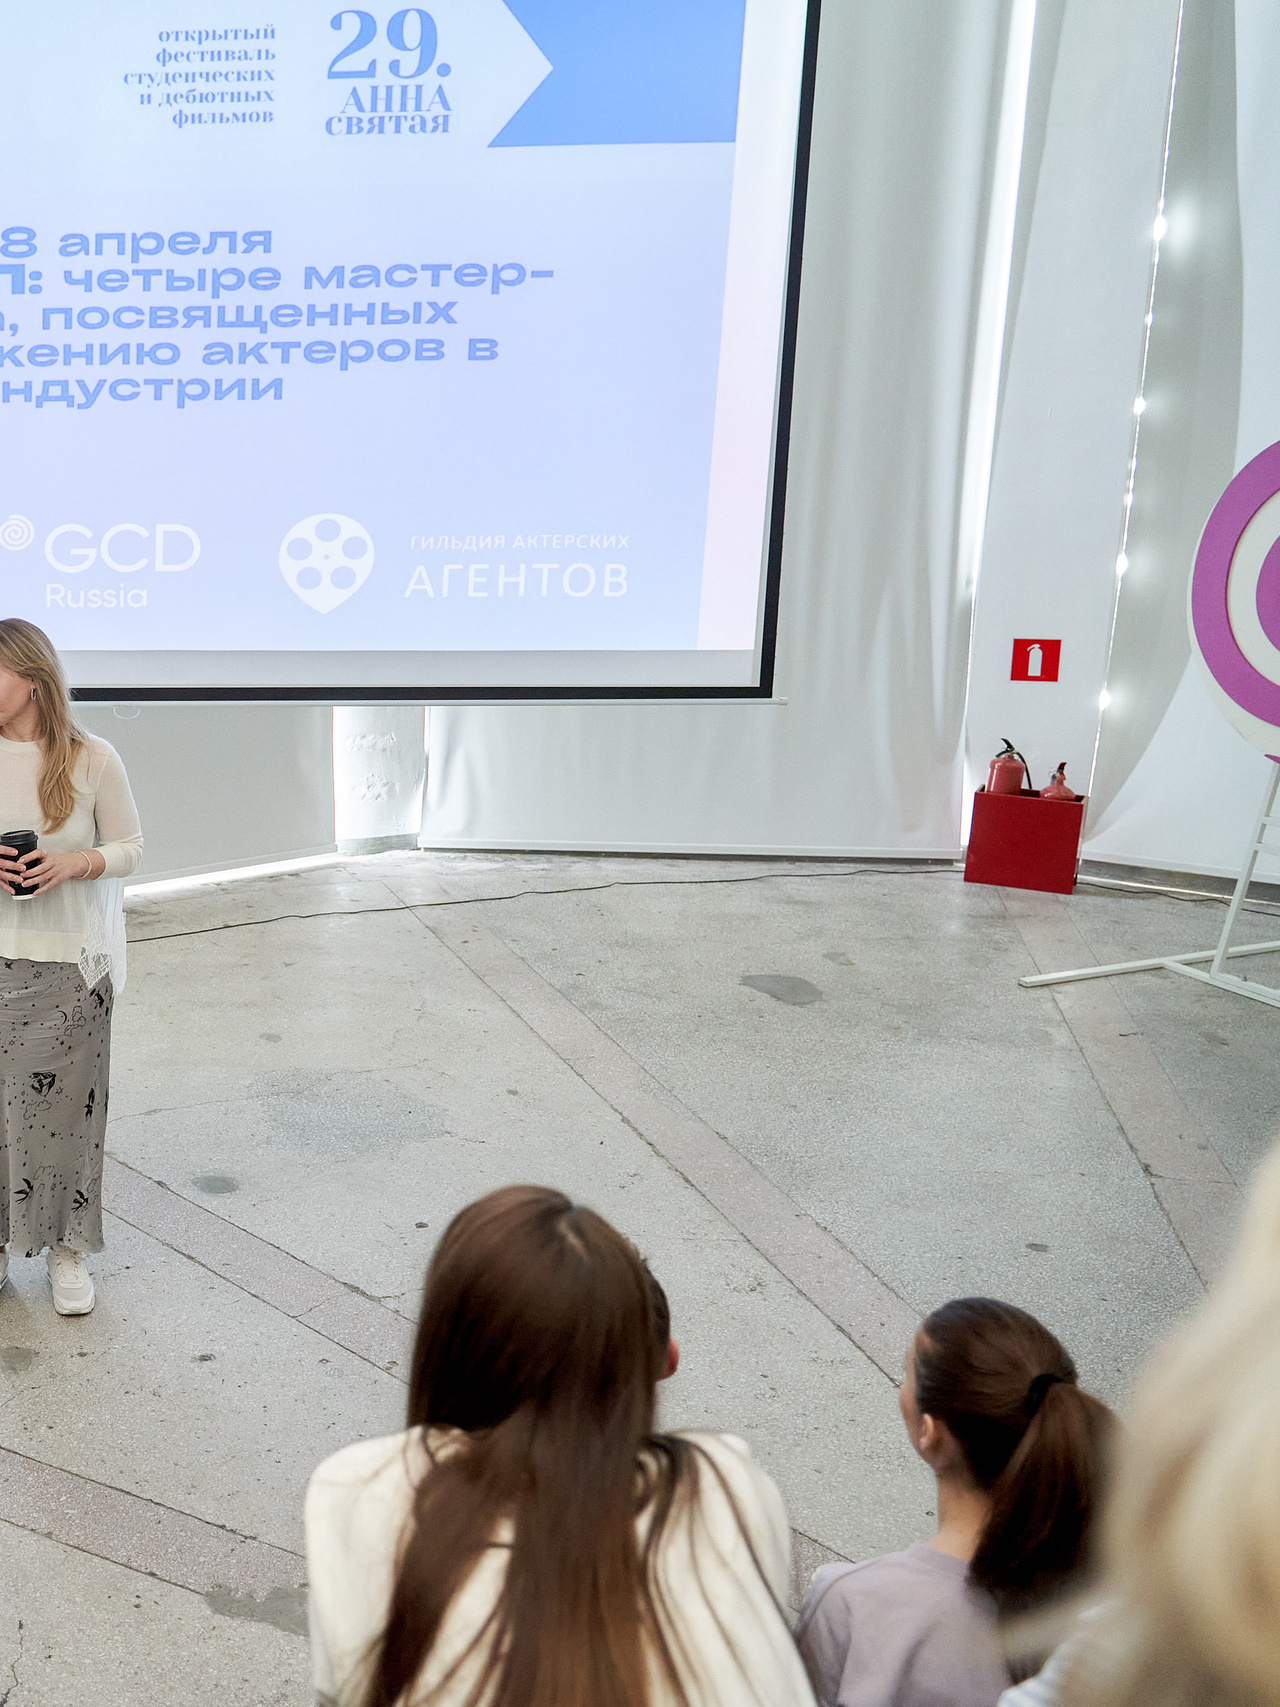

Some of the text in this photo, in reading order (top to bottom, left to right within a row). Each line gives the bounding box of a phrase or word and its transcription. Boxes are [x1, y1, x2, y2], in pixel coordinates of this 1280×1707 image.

[158, 24, 276, 46] открытый
[326, 8, 452, 80] 29.
[155, 47, 276, 68] фестиваль
[123, 69, 275, 88] студенческих
[139, 88, 275, 108] и дебютных
[339, 84, 453, 114] АННА
[172, 109, 274, 129] фильмов
[324, 114, 451, 136] святая
[58, 230, 272, 264] апреля
[63, 266, 282, 300] четыре
[303, 262, 555, 296] мастер-
[41, 301, 459, 335] посвященных
[202, 338, 446, 372] актеров
[467, 337, 499, 362] в
[44, 523, 201, 573] GCD
[411, 534, 629, 553] ГИЛЬДИЯ АКТЕРСКИХ
[403, 562, 628, 598] АГЕНТОВ
[46, 582, 148, 609] Russia
